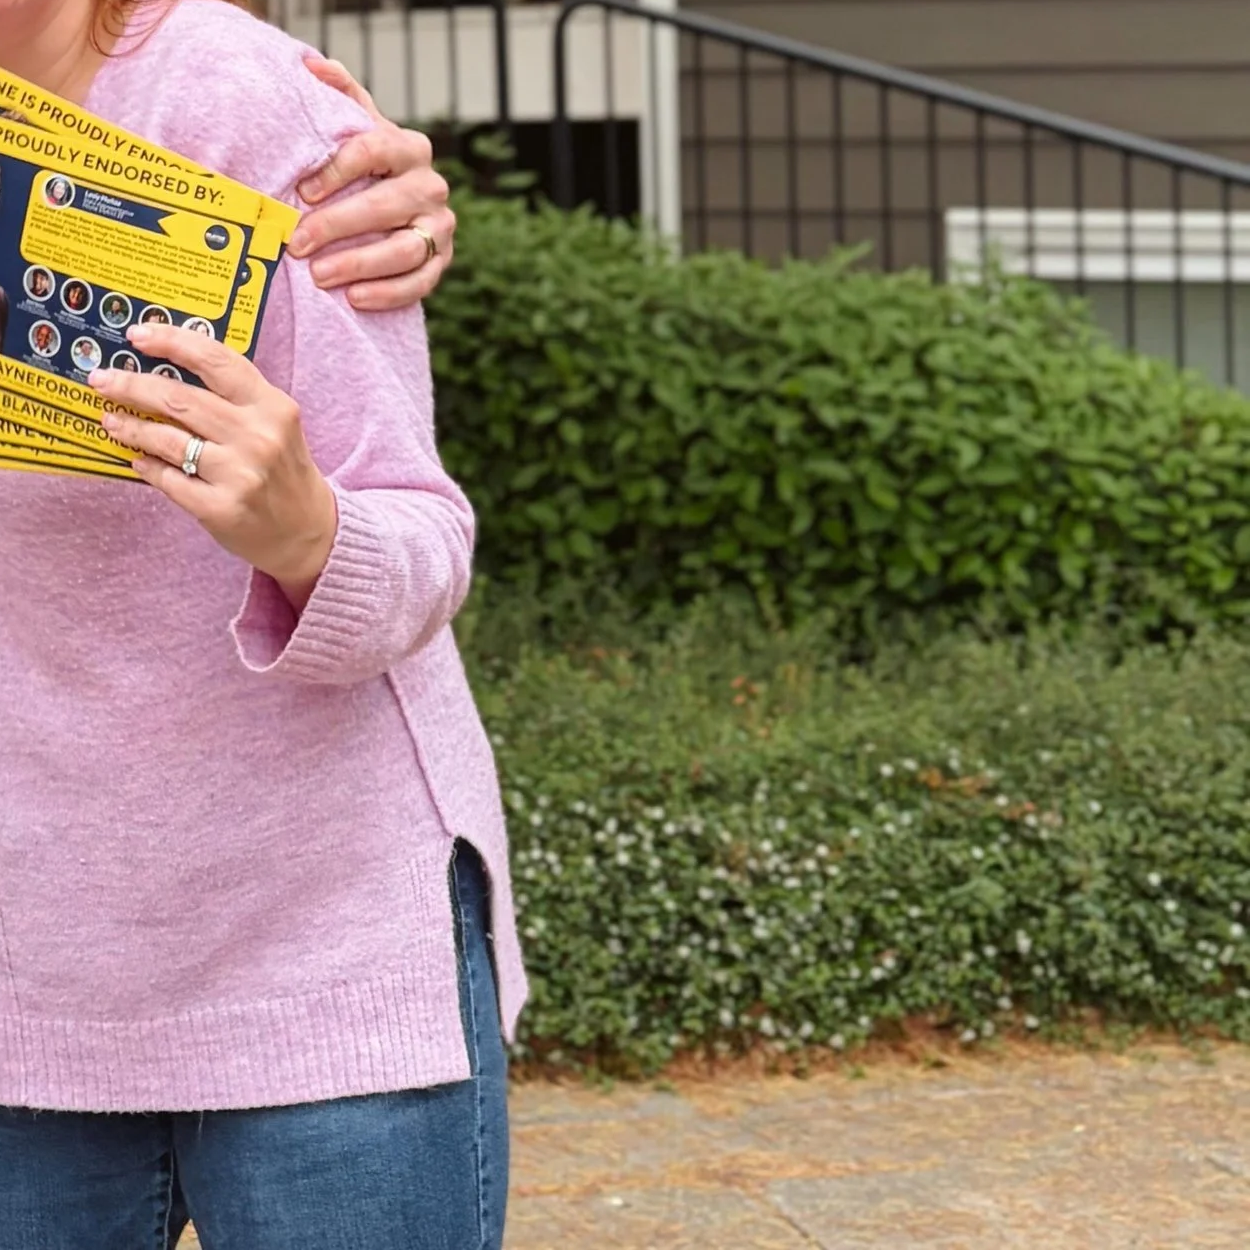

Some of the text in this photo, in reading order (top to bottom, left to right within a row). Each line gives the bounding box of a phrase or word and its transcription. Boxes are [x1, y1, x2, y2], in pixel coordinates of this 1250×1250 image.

[20, 91, 36, 110] IS
[38, 101, 127, 151] PROUDLY
[83, 154, 190, 195] ENDORSED
[194, 185, 225, 206] BY:
